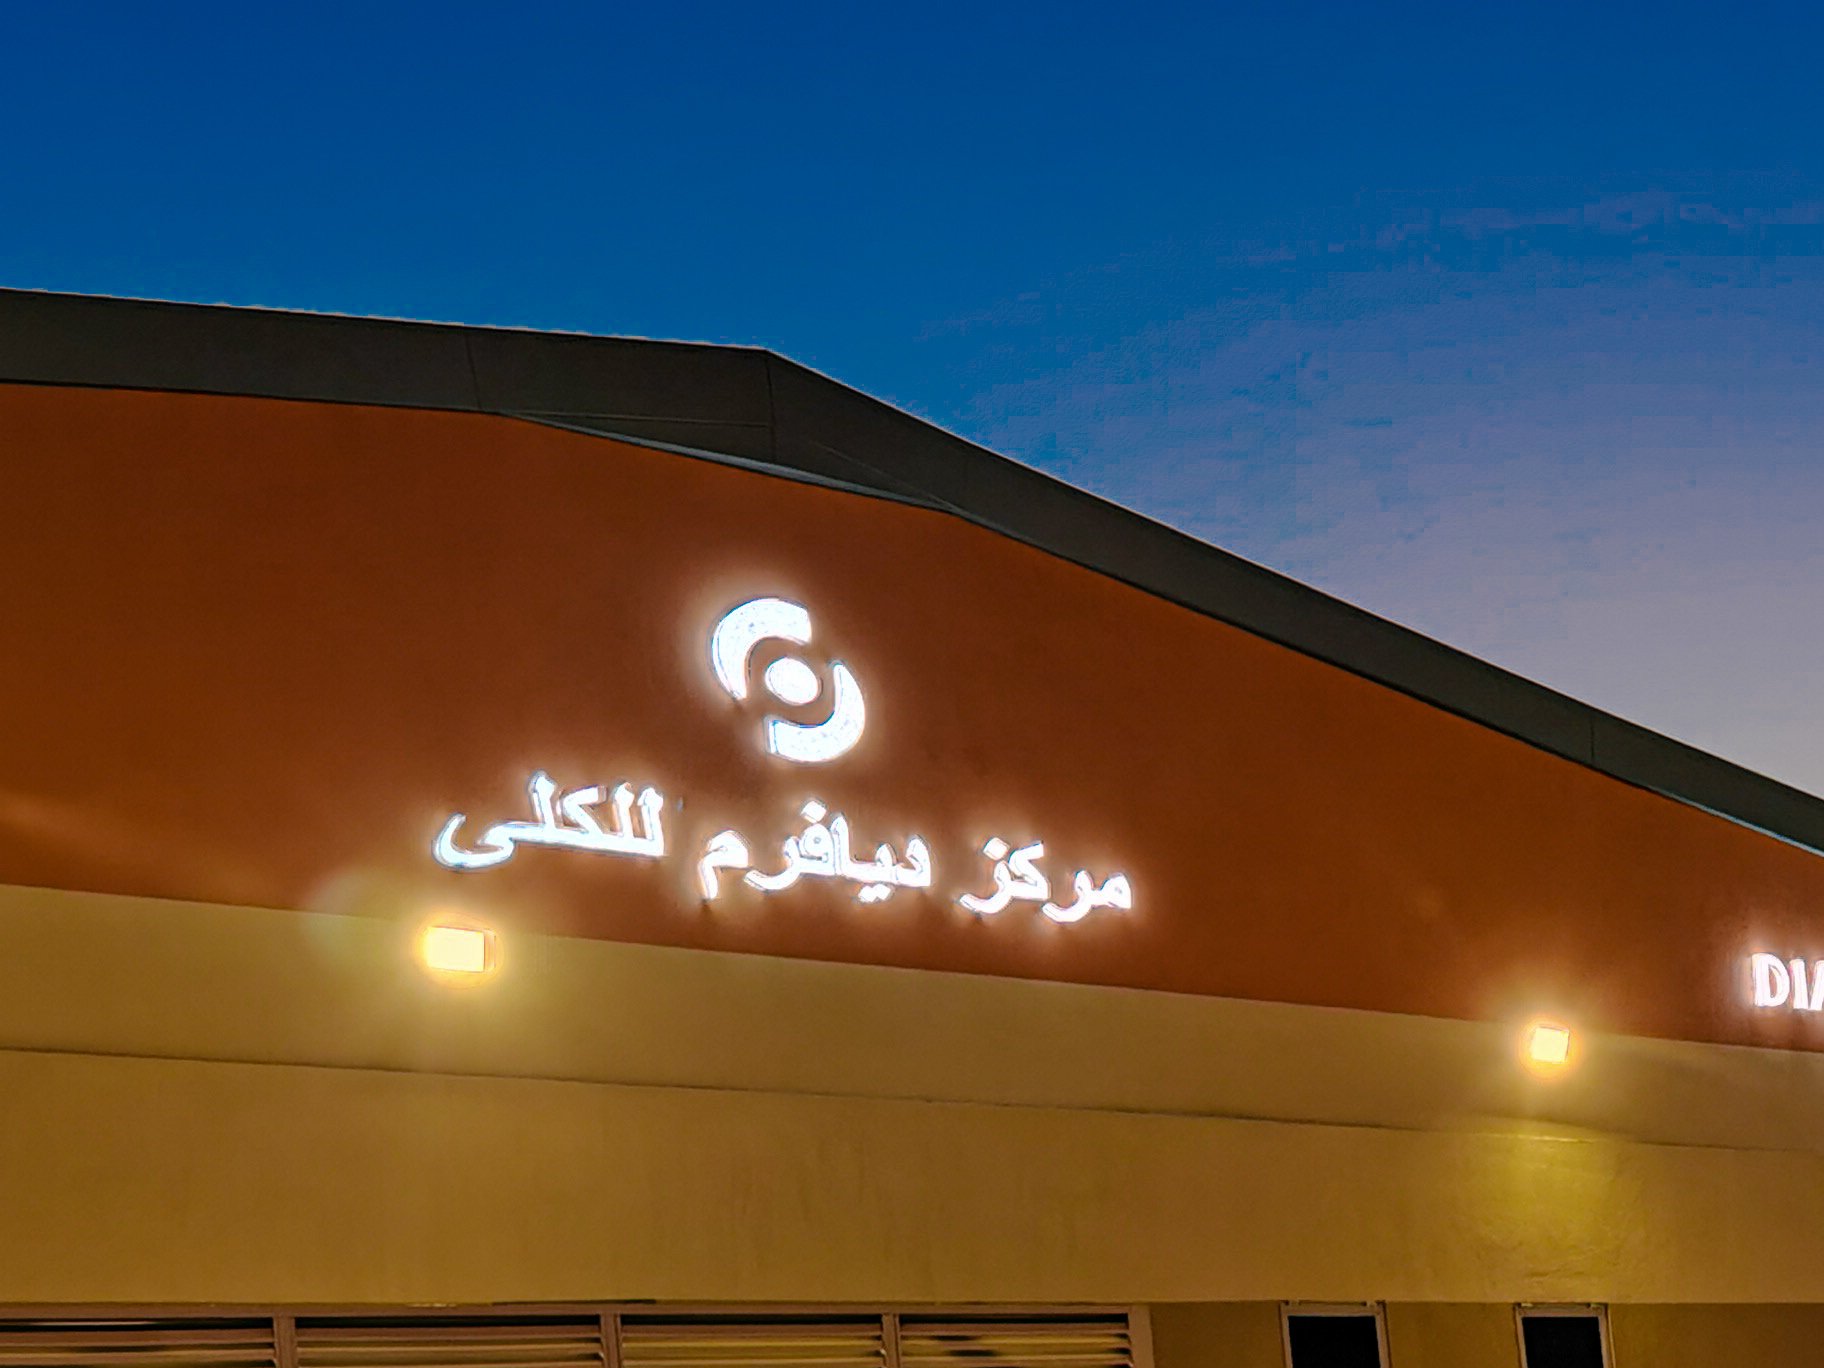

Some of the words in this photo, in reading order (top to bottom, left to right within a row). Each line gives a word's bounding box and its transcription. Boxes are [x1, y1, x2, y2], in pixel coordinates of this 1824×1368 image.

[431, 771, 665, 871] للكلى
[698, 799, 932, 902] ديافرم
[957, 836, 1132, 923] مركز
